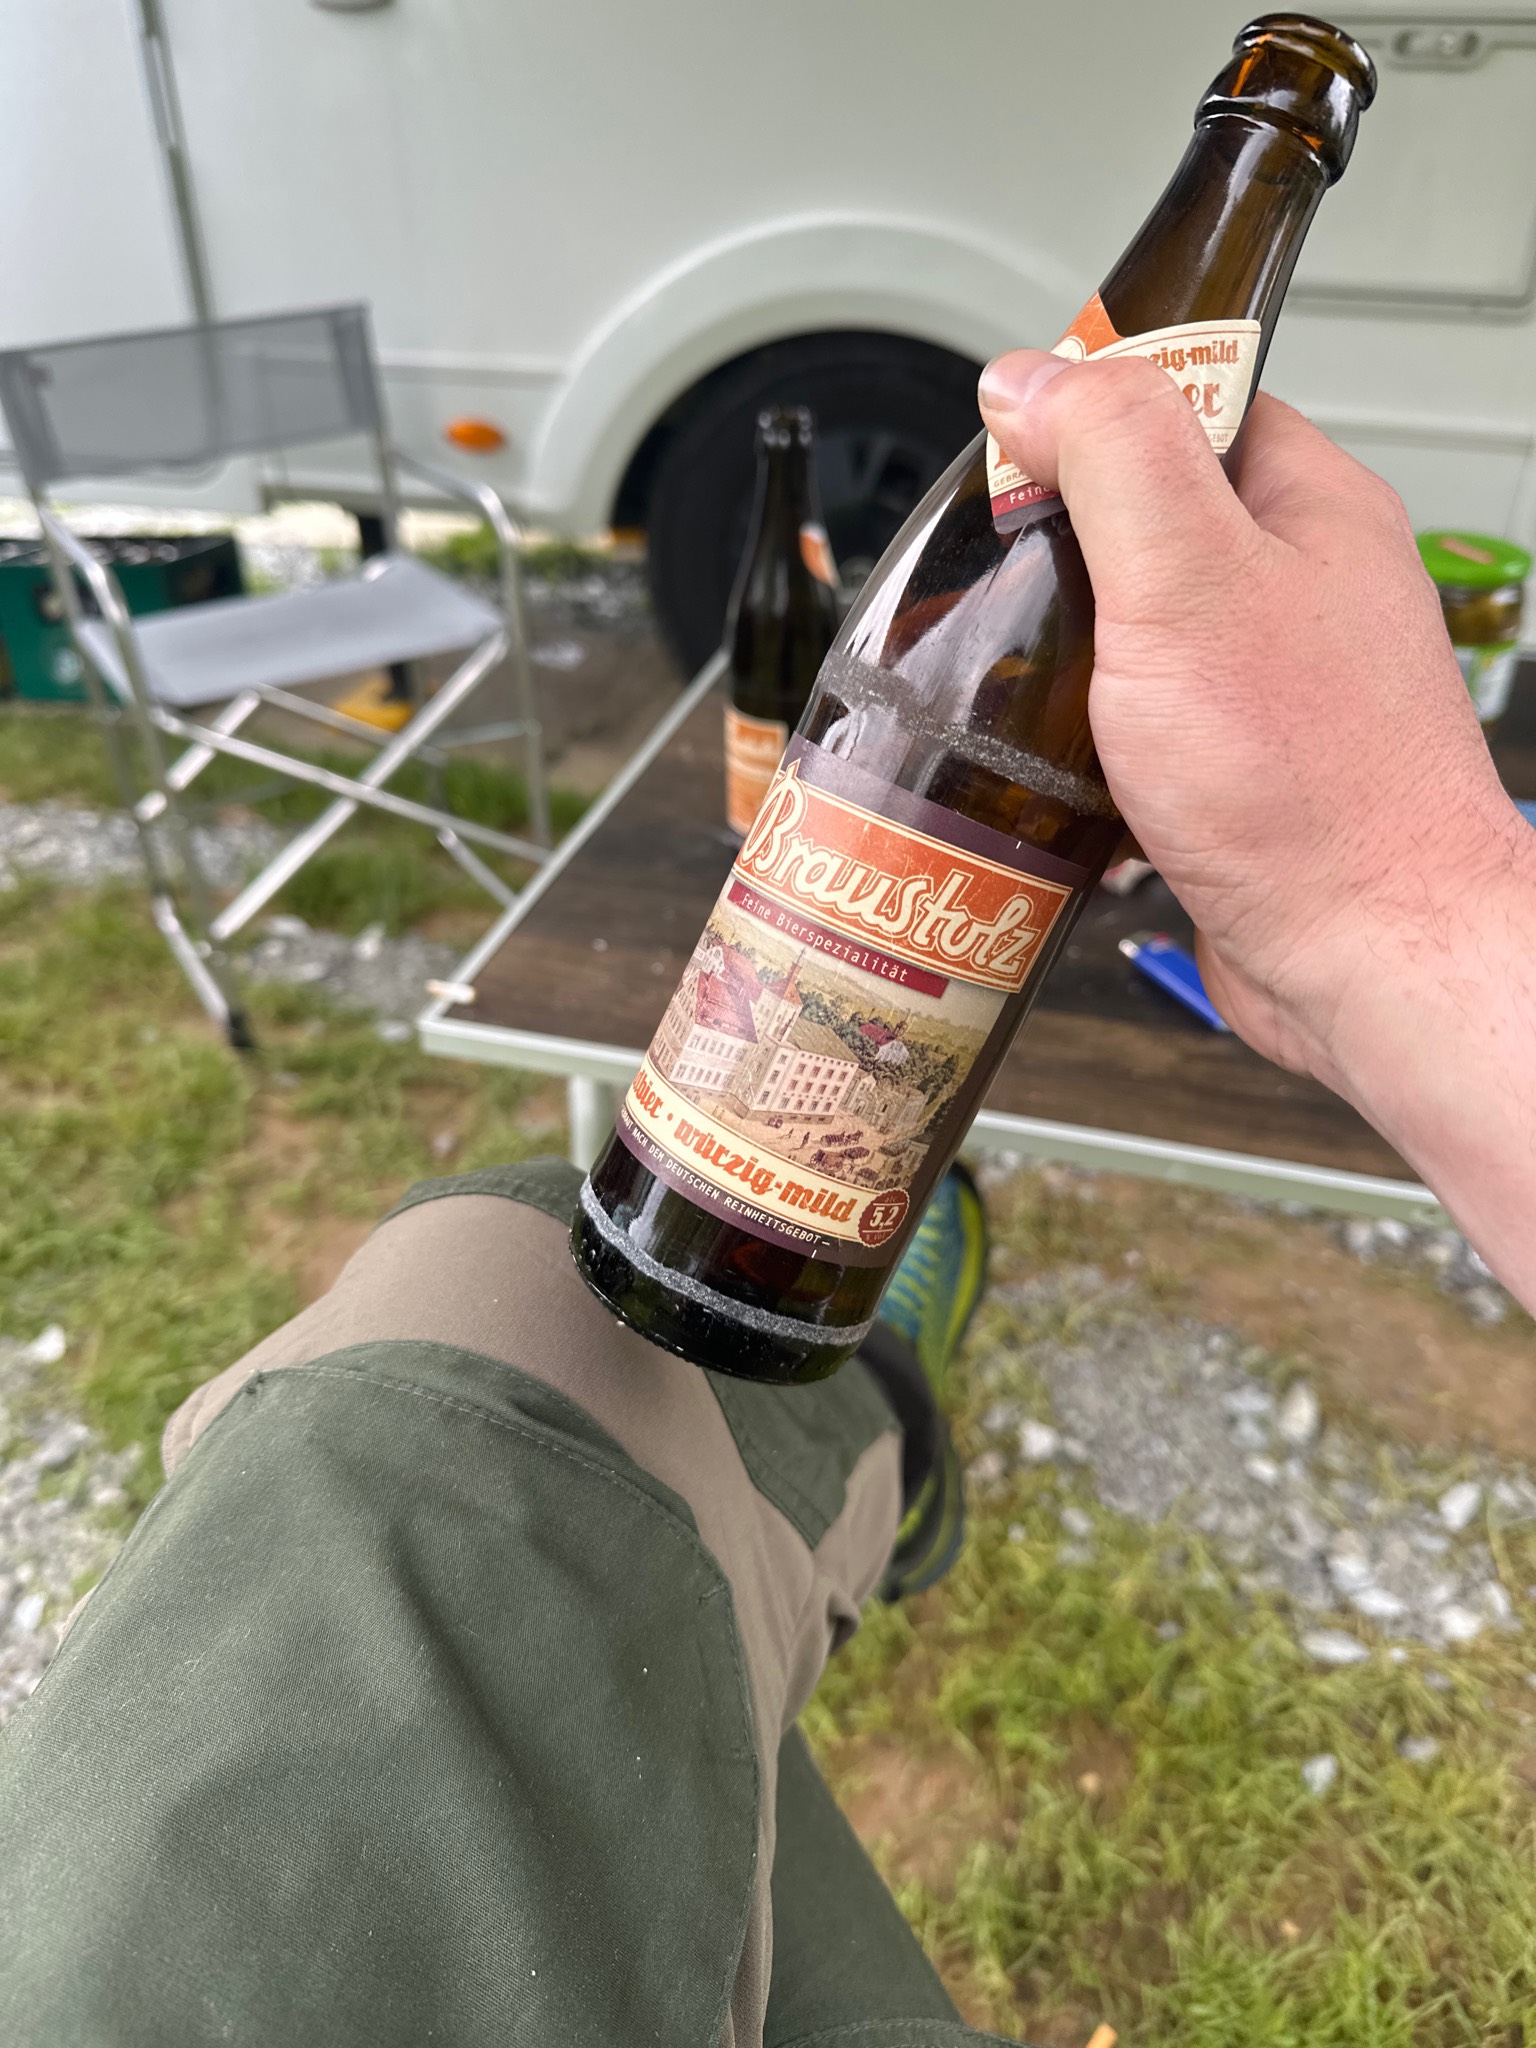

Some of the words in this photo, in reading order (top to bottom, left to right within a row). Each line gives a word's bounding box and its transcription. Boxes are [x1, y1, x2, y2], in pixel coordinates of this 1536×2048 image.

[1148, 339, 1239, 371] zig-mild
[993, 470, 1026, 488] GEBRA
[741, 759, 1038, 975] Braustolz
[741, 893, 770, 920] Feine
[776, 912, 908, 983] Bierspezialität
[631, 1126, 649, 1148] NACH
[648, 1144, 665, 1162] DEM
[665, 1159, 720, 1200] DEUTSCHEN
[674, 1118, 858, 1223] würzig-mild
[869, 1205, 900, 1230] 5,2
